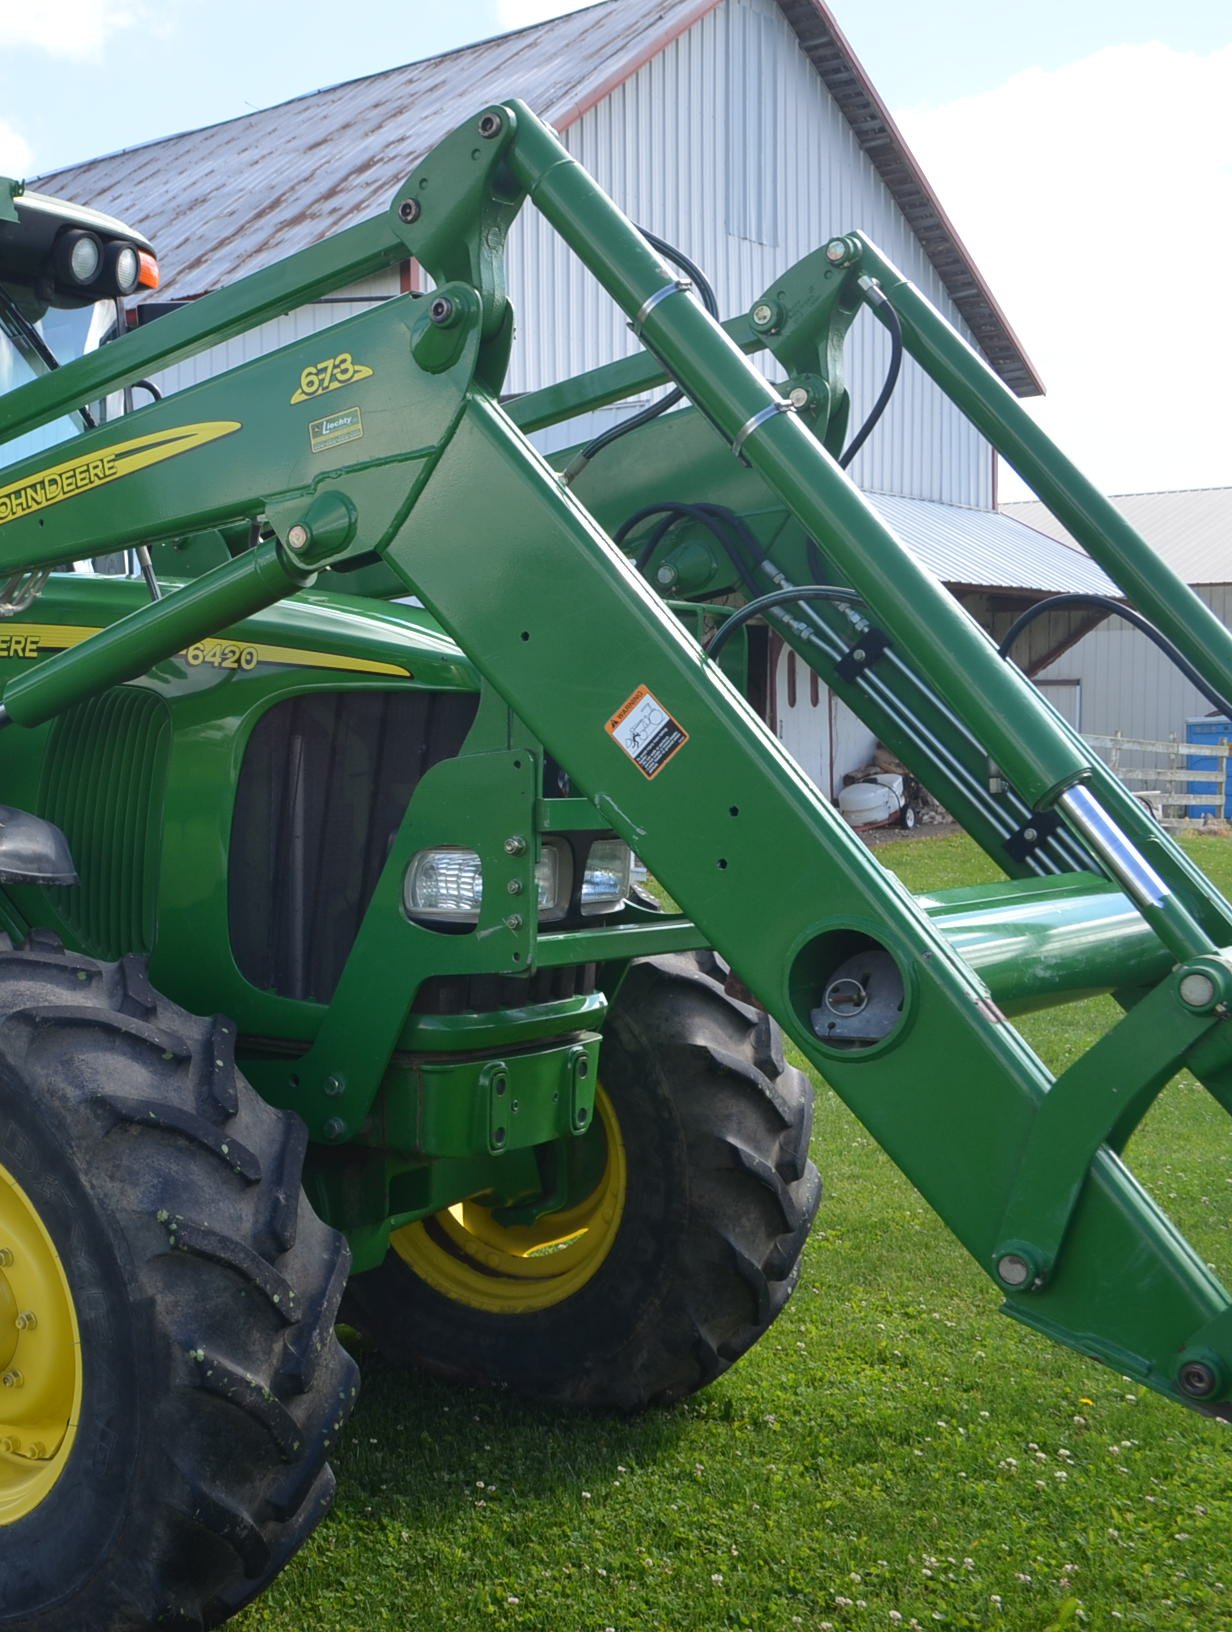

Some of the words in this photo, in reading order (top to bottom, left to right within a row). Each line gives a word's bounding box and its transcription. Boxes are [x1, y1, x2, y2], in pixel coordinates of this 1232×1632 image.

[300, 352, 355, 396] 673
[186, 642, 258, 671] 6420
[616, 689, 644, 721] WARNING
